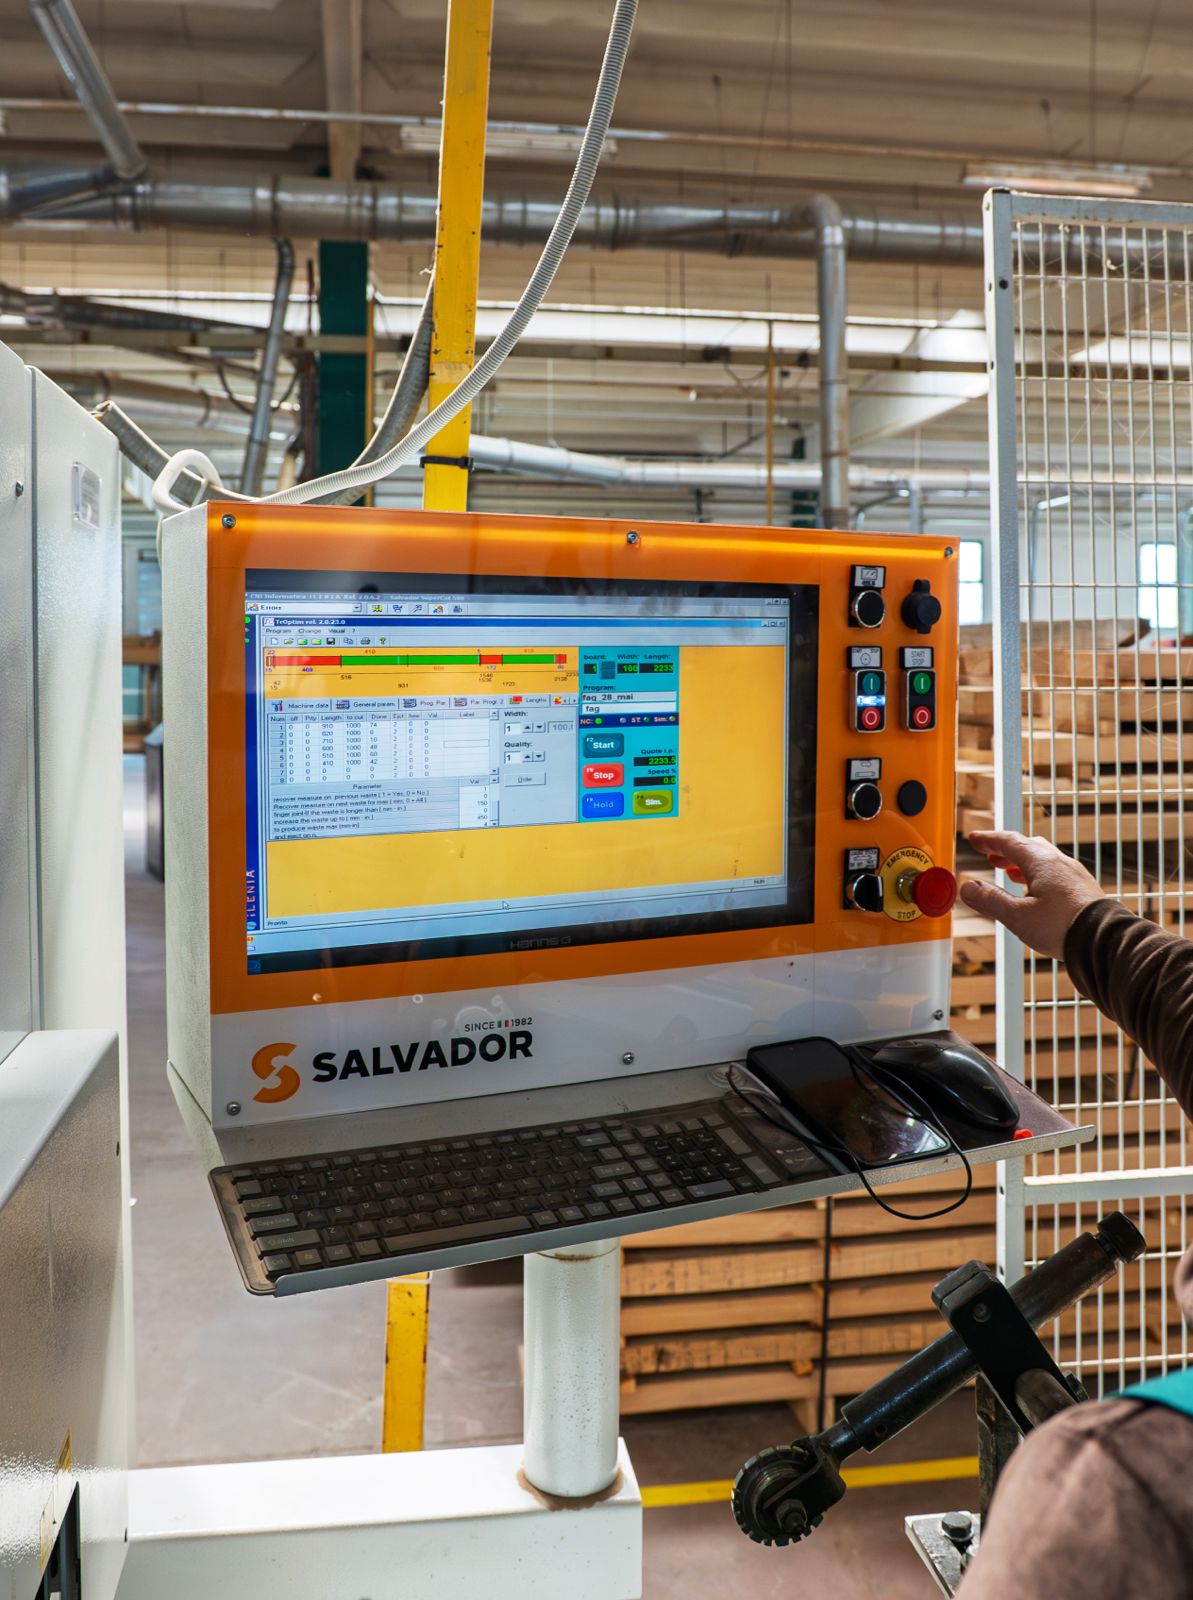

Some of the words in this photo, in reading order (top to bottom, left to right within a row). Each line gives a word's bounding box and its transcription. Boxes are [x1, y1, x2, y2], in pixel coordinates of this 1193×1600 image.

[593, 772, 614, 780] Stop
[886, 849, 929, 868] EMERGENCY
[898, 910, 916, 919] STOP
[464, 1020, 495, 1032] SINCE
[510, 1017, 533, 1027] 1982
[312, 1030, 534, 1082] SALVADOR
